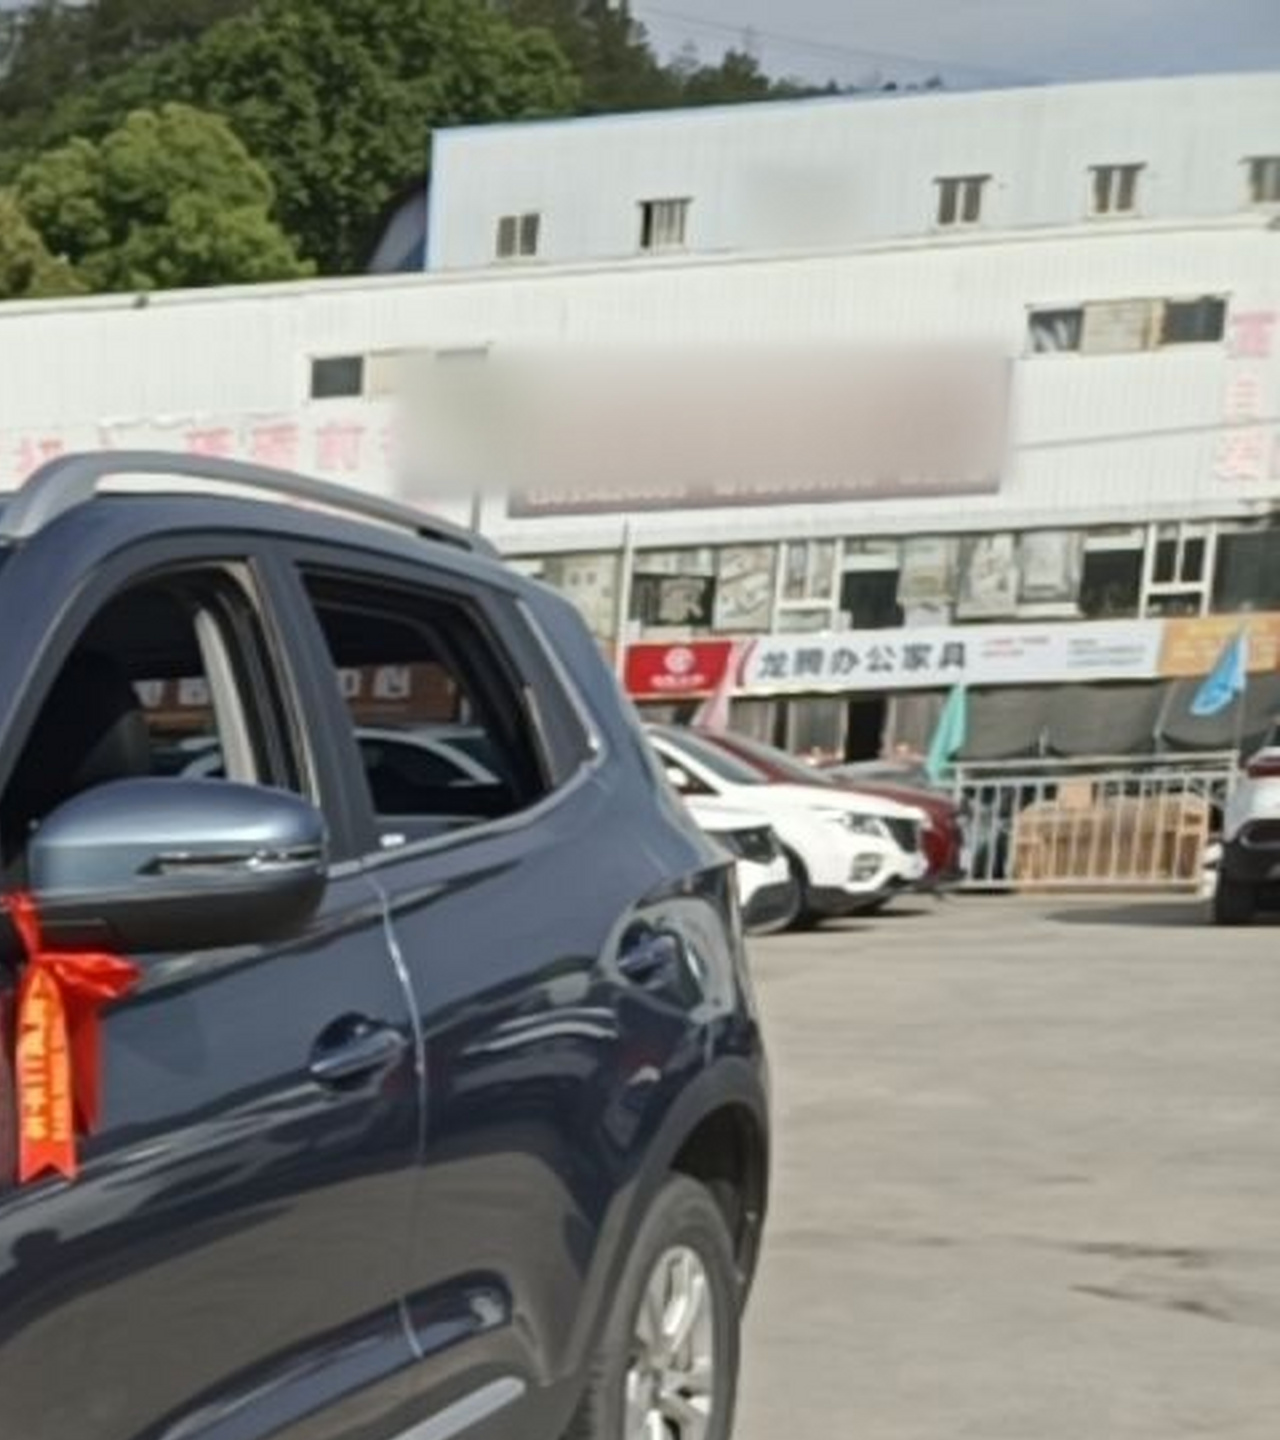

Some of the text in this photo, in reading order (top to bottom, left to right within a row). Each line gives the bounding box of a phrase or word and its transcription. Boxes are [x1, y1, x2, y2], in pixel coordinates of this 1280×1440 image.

[758, 641, 968, 680] 龙腾办公家具
